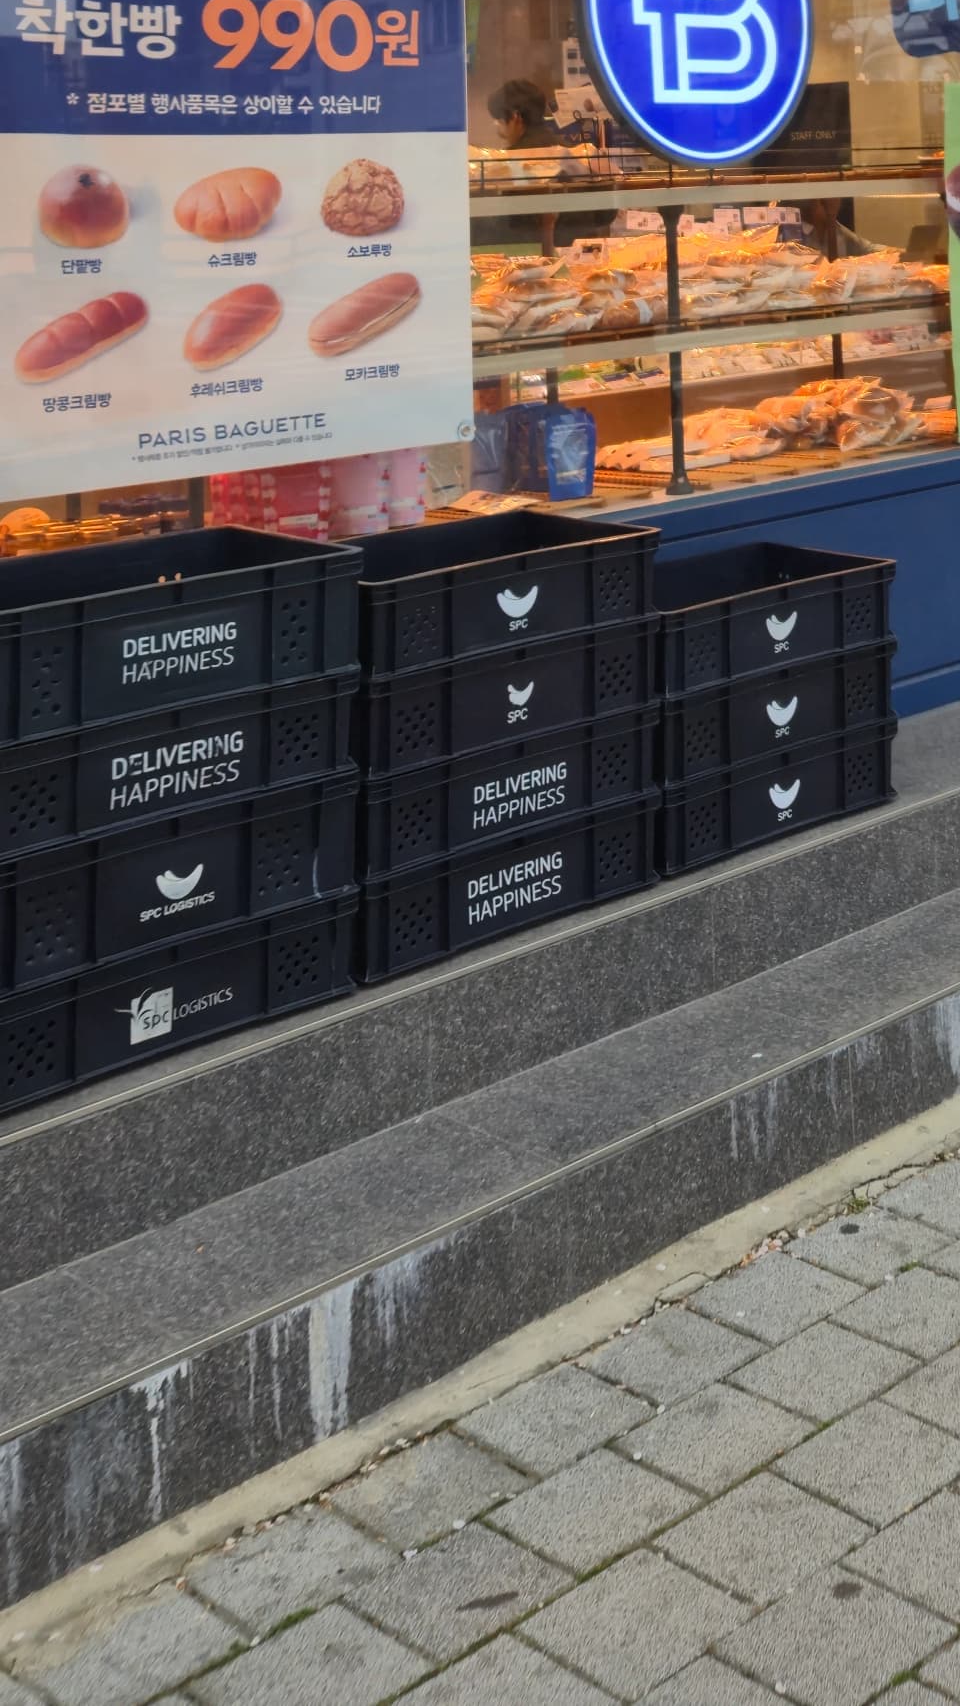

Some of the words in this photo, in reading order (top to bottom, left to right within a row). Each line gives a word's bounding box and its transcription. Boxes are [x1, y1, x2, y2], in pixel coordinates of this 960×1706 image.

[86, 92, 146, 115] 점포별
[151, 94, 238, 116] 행사품목은
[243, 95, 294, 116] 상이할
[298, 96, 315, 116] 수
[319, 95, 381, 115] 있습니다
[207, 251, 257, 268] 슈크림빵
[347, 244, 392, 259] 소보루빵
[61, 258, 102, 275] 단팥빵
[345, 363, 401, 382] 모카크림빵
[189, 378, 263, 398] 후레쉬크림빵
[43, 392, 112, 413] 땅콩크림빵
[138, 427, 206, 449] PARIS
[215, 412, 326, 440] BAGUETTE
[508, 618, 529, 632] SPC
[123, 621, 237, 658] DELIVERING
[774, 640, 790, 654] SPC
[122, 646, 235, 685] HAPPINESS
[507, 707, 529, 724] SPC
[775, 726, 790, 739] SPC
[111, 730, 244, 780] DELIVERING
[110, 759, 240, 811] HAPPINESS
[473, 762, 567, 805] DELIVERING
[473, 785, 565, 829] HAPPINESS
[777, 808, 793, 822] SPC
[468, 851, 563, 899] DELIVERING
[139, 906, 161, 923] SPC
[164, 891, 215, 916] LOGISTICS
[468, 874, 562, 925] HAPPINESS
[173, 986, 234, 1022] LOGISTICS
